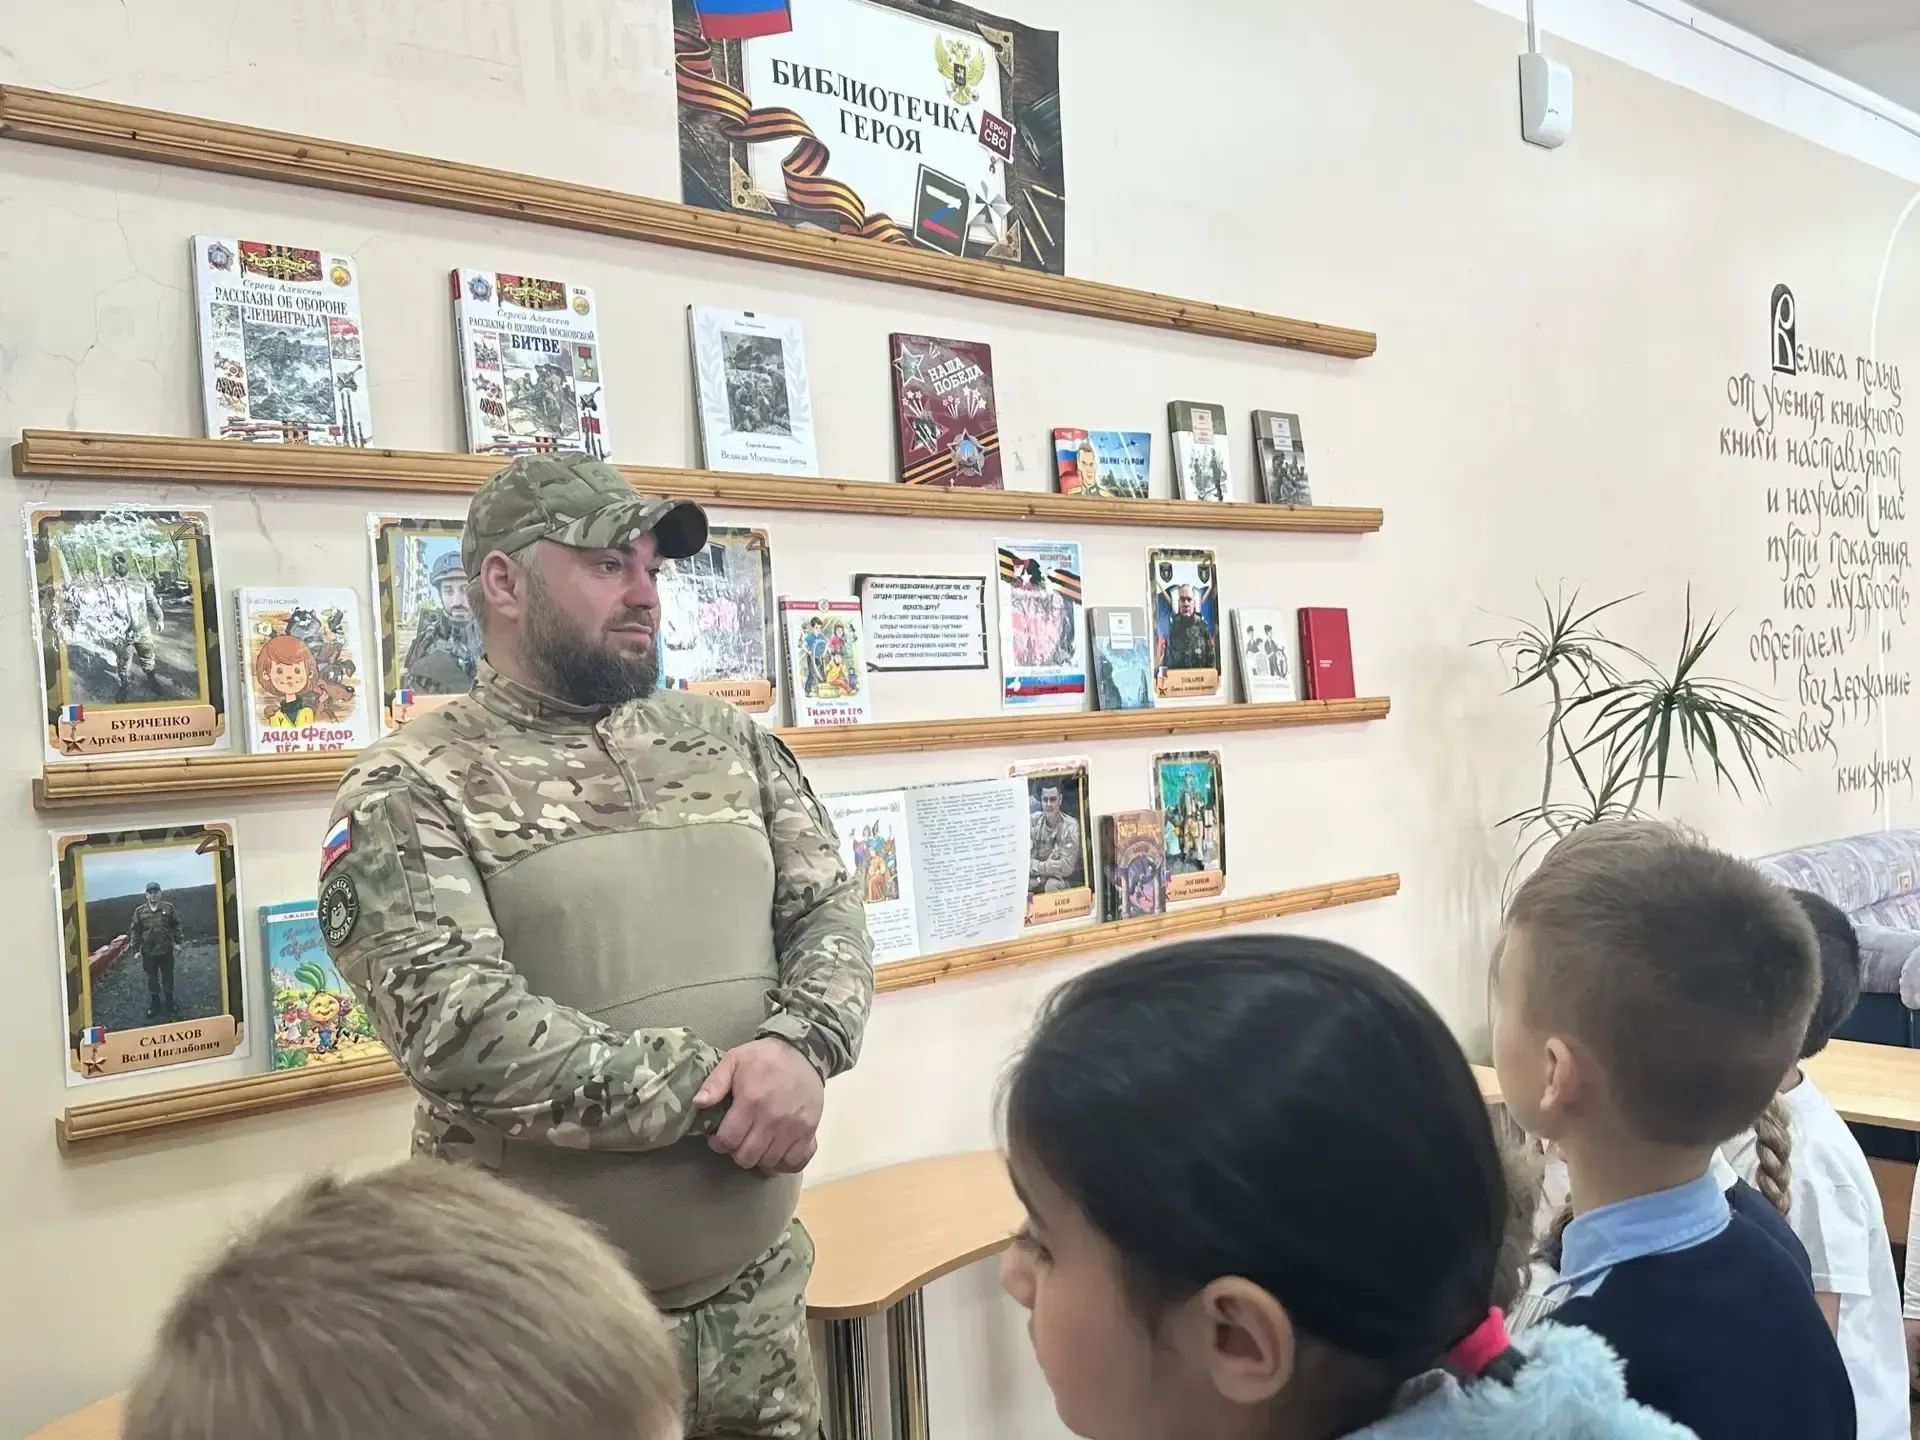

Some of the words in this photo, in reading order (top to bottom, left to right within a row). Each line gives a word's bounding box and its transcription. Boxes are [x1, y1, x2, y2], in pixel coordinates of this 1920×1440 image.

[771, 58, 977, 135] БИБЛИОТЕЧКА
[840, 109, 923, 154] ГЕРОЯ
[984, 129, 1007, 150] СВО
[242, 279, 275, 292] Сергей
[279, 284, 322, 296] Алексеев
[215, 287, 273, 306] РАССКАЗЫ
[277, 294, 292, 308] ОБ
[296, 297, 348, 316] ОБОРОНЕ
[246, 306, 322, 329] ЛЕНИНГРАДА
[469, 316, 505, 330] РАССКАЗЫ
[507, 323, 513, 331] О
[515, 322, 547, 335] ВЕЛИКОЙ
[549, 326, 595, 341] МОСКОВСКОЙ
[497, 309, 527, 320] Сергей
[530, 314, 570, 326] Алексеев
[511, 334, 560, 354] БИТВЕ
[1771, 283, 1848, 380] Велика
[928, 356, 966, 382] НАША
[932, 364, 985, 396] ПОБЕДА
[1728, 373, 1769, 428] от
[1831, 395, 1904, 447] книжного
[721, 449, 748, 461] Великая
[749, 452, 789, 465] Московская
[1720, 427, 1777, 460] книги
[1787, 430, 1906, 495] наставляют
[1767, 487, 1779, 513] и
[1787, 480, 1880, 538] научают
[1879, 495, 1906, 521] нас
[1767, 522, 1821, 582] пути
[1784, 573, 1816, 610] ибо
[1827, 572, 1911, 643] мудрость
[1750, 618, 1845, 690] обретаем
[1882, 630, 1892, 653] и
[709, 689, 751, 697] КАМИЛОВ
[111, 715, 191, 731] БУРЯЧЕНКО
[88, 734, 125, 747] Артём
[128, 728, 213, 744] Владимирович
[261, 730, 299, 744] ДЯДЯ
[1838, 748, 1914, 815] книжных
[329, 916, 352, 940] БОРОДА
[140, 1029, 202, 1047] САЛАХОВ
[122, 1053, 149, 1064] Вели
